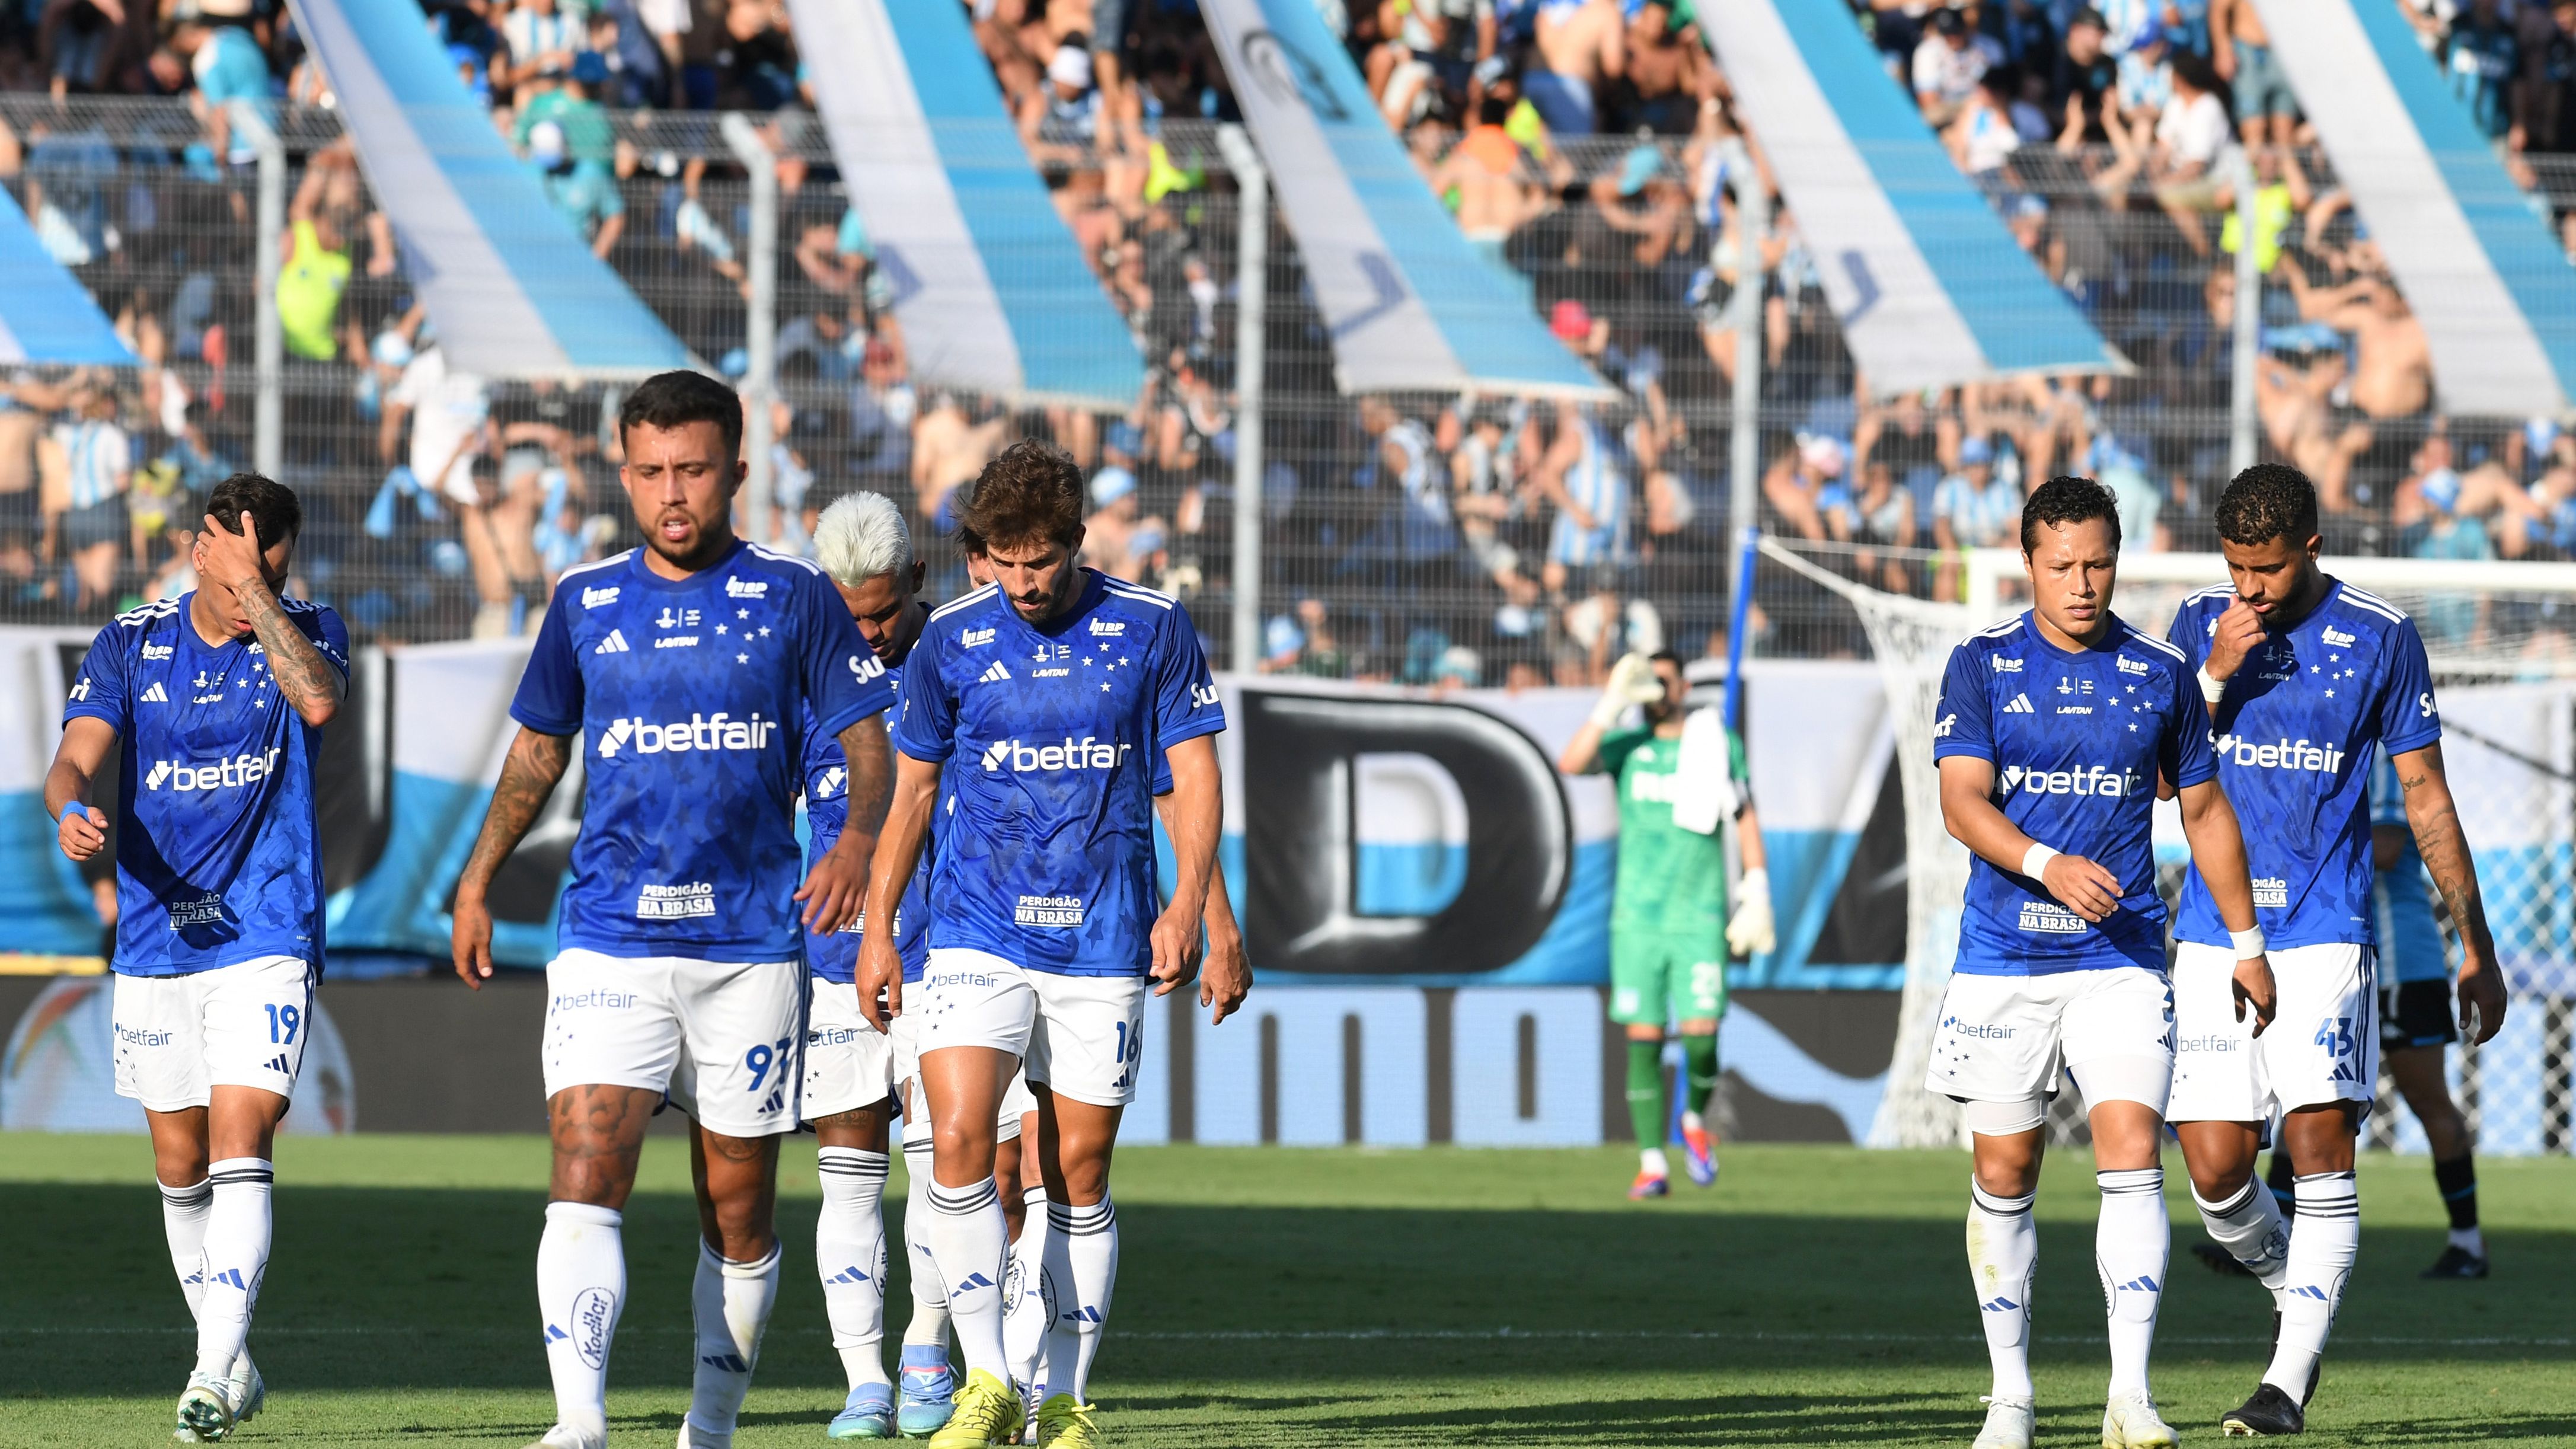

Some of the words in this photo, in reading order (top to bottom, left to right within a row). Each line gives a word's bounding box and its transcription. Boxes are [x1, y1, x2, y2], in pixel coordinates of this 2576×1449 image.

[1032, 668, 1070, 678] LAVITAN
[2056, 706, 2093, 714] LAVITAN
[633, 712, 777, 754] betfair
[1013, 736, 1132, 771] betfair
[2235, 735, 2344, 774] betfair
[173, 745, 282, 791] betfair
[2025, 764, 2141, 797] betfair
[642, 881, 713, 897] PERDIGÃO
[637, 900, 661, 915] NA
[662, 898, 716, 915] BRASA
[1019, 895, 1081, 908] PERDIGÃO
[1014, 909, 1036, 923] NA
[1036, 911, 1083, 924] BRASA
[2019, 915, 2039, 928] NA
[2040, 917, 2087, 930] BRASA
[937, 972, 998, 988] betfair
[563, 988, 638, 1010] betfair
[120, 1024, 173, 1046] betfair
[264, 1004, 300, 1045] 19
[1956, 1019, 2016, 1039] betfair
[1116, 1019, 1139, 1064] 16
[2180, 1035, 2240, 1052] betfair
[2314, 1017, 2354, 1057] 43
